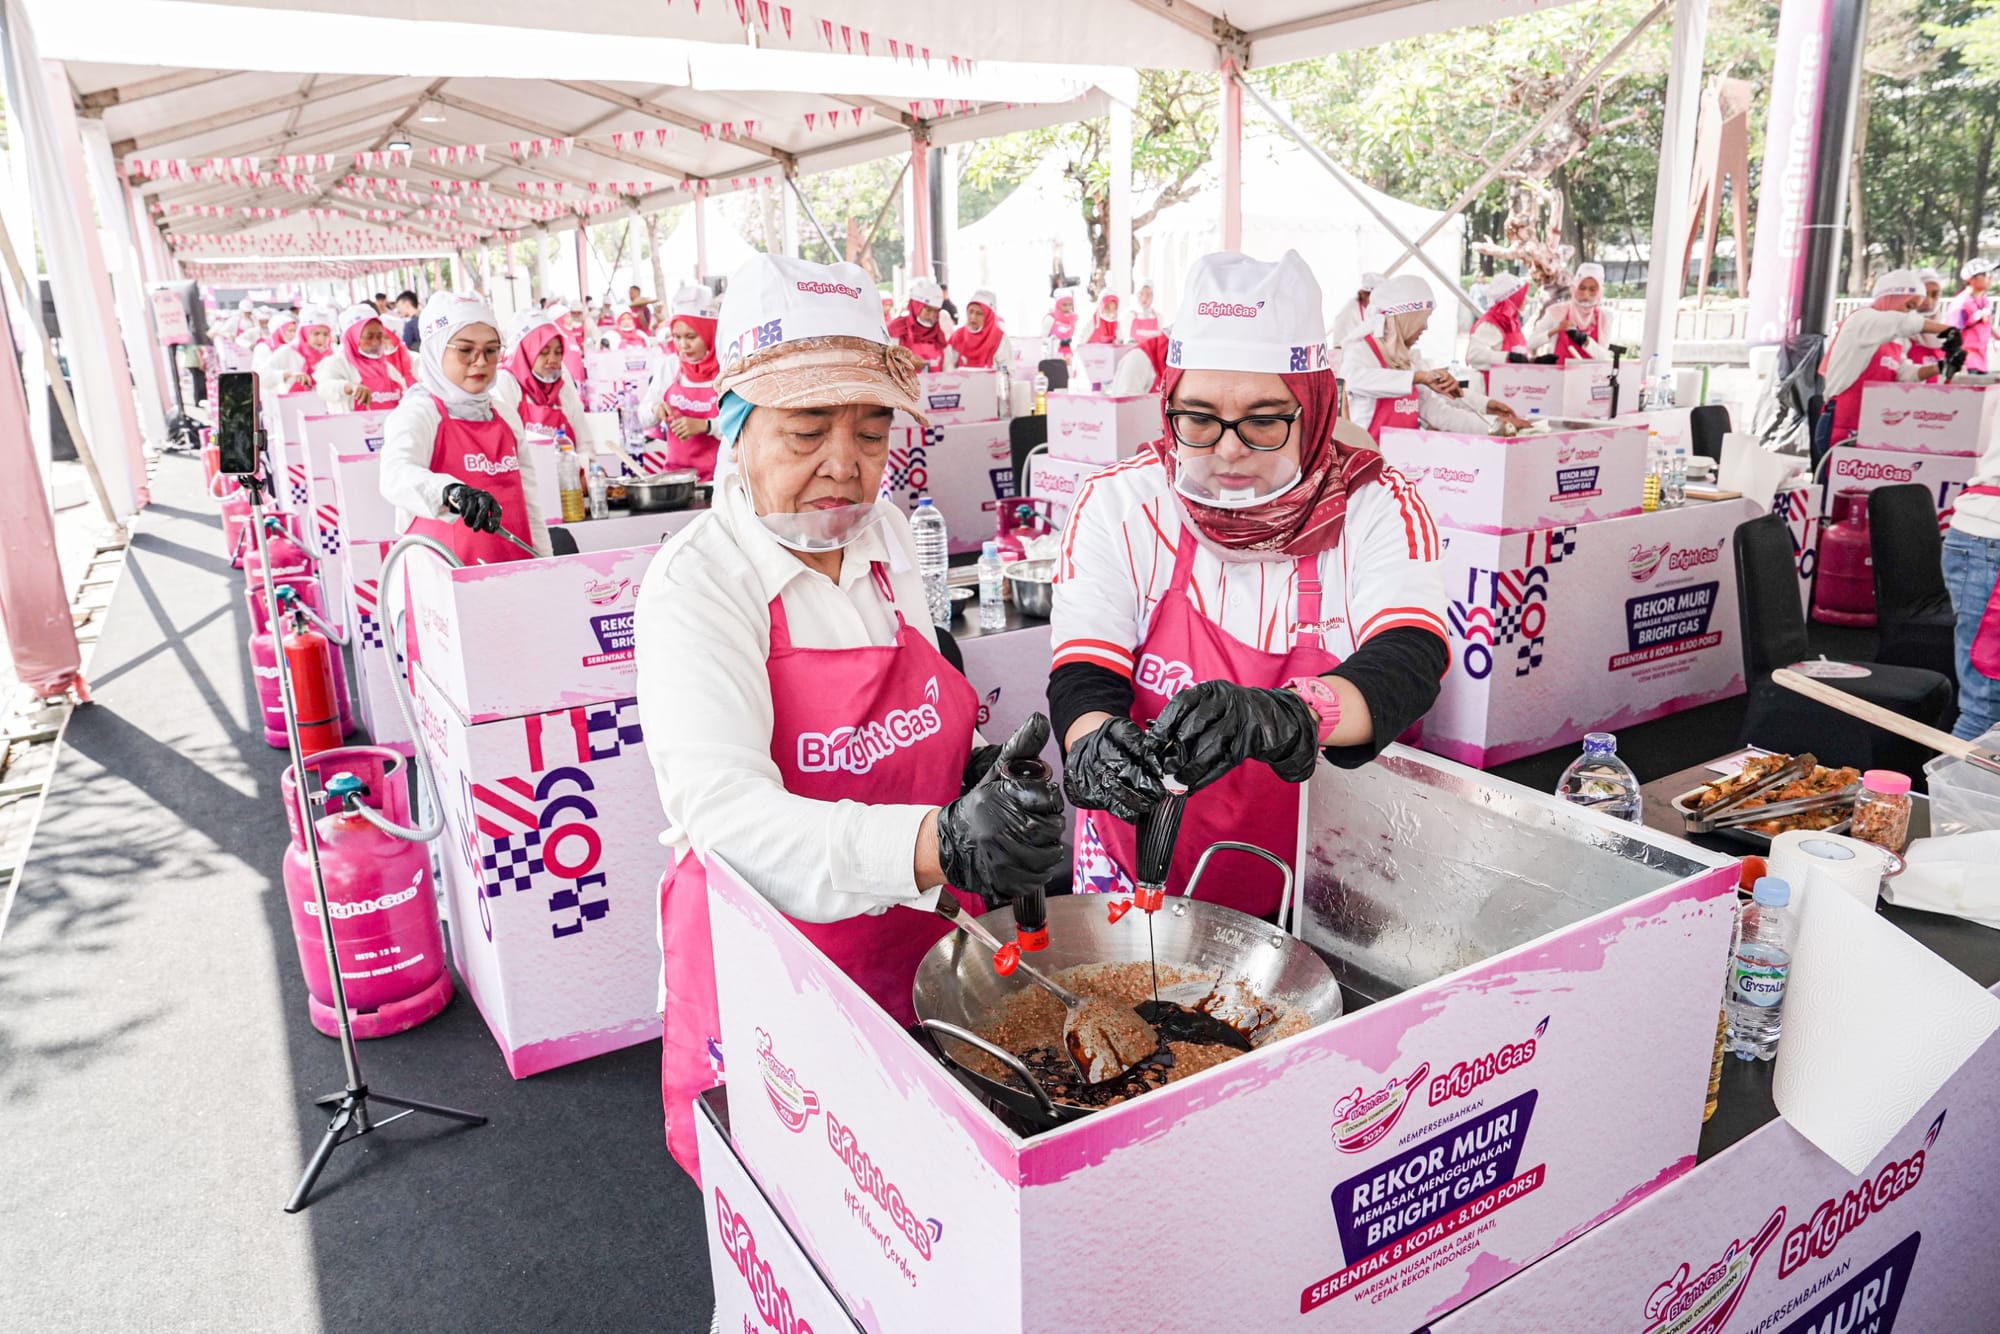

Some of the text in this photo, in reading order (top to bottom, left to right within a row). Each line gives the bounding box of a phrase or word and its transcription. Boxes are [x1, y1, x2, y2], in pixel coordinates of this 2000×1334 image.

[1633, 589, 1711, 620] REKOR MURI
[1638, 618, 1700, 645] BRIGHT GAS
[304, 900, 375, 919] Bight
[1398, 1099, 1485, 1147] MEMPERSEMBAHKAN
[1352, 1108, 1519, 1214] REKOR MURI
[1353, 1138, 1513, 1229] MEMASAK MENGGUNAKAN
[1310, 1254, 1390, 1304] SERENTAK
[1392, 1243, 1402, 1258] 8
[1405, 1226, 1445, 1254] KOTA
[1458, 1198, 1495, 1225] 8.100
[1497, 1172, 1538, 1204] PORSI
[1366, 1161, 1497, 1247] BRIGHT GAS
[1354, 1272, 1398, 1302] WARISAN
[1400, 1243, 1454, 1277] NUSANTARA
[1456, 1231, 1475, 1247] DARI
[1371, 1239, 1481, 1305] CETAK REKOR INDONESIA
